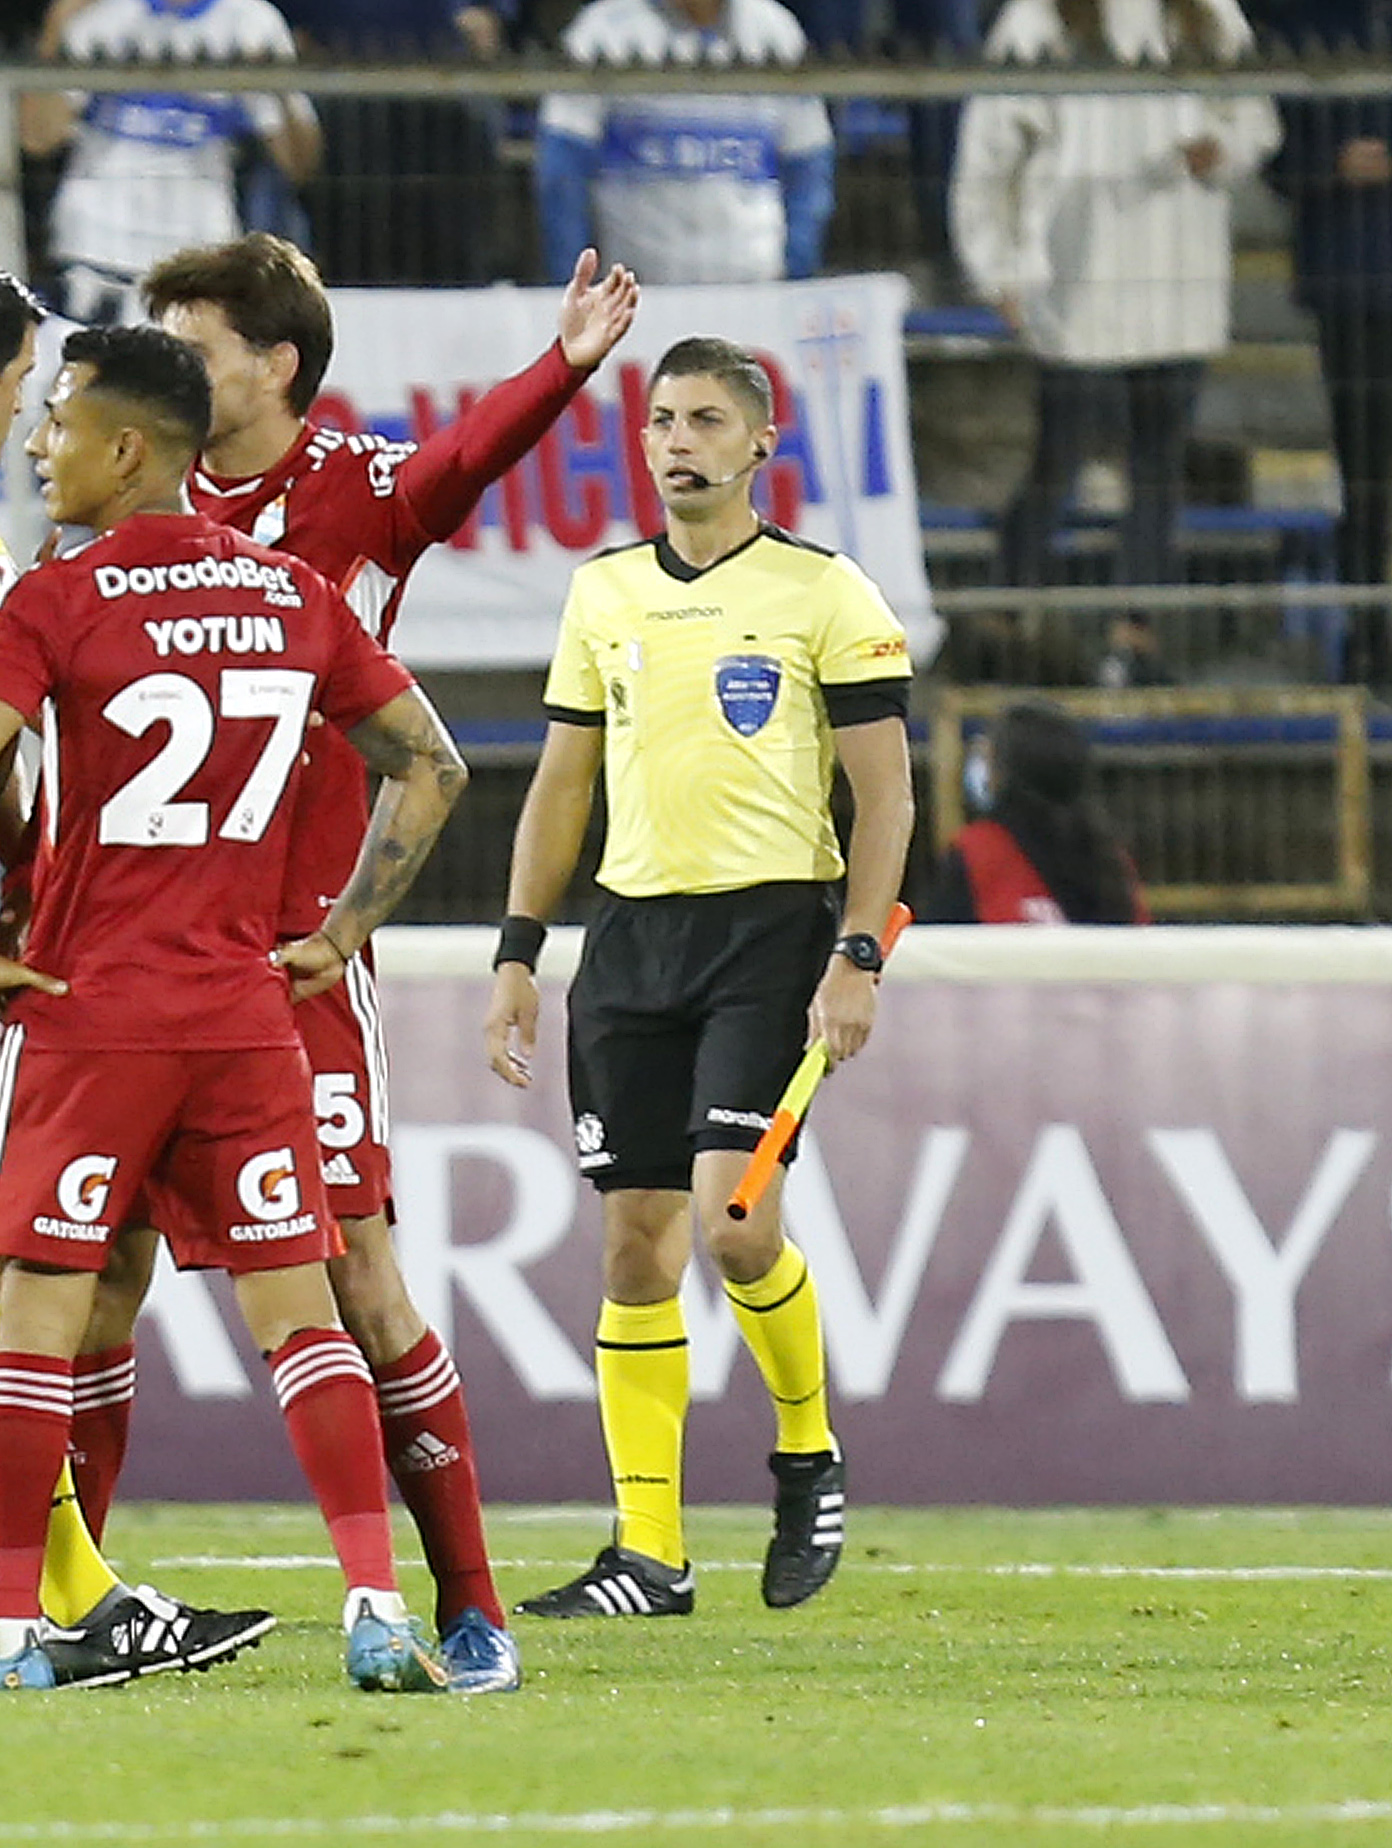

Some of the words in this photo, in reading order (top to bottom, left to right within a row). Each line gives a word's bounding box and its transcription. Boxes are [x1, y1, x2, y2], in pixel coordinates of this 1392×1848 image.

[94, 556, 296, 598] DoradoBet
[646, 605, 723, 621] marathon
[143, 616, 285, 656] YOTUN
[98, 671, 316, 846] 27
[33, 1216, 110, 1242] GATORADE
[229, 1215, 316, 1241] GATORADE
